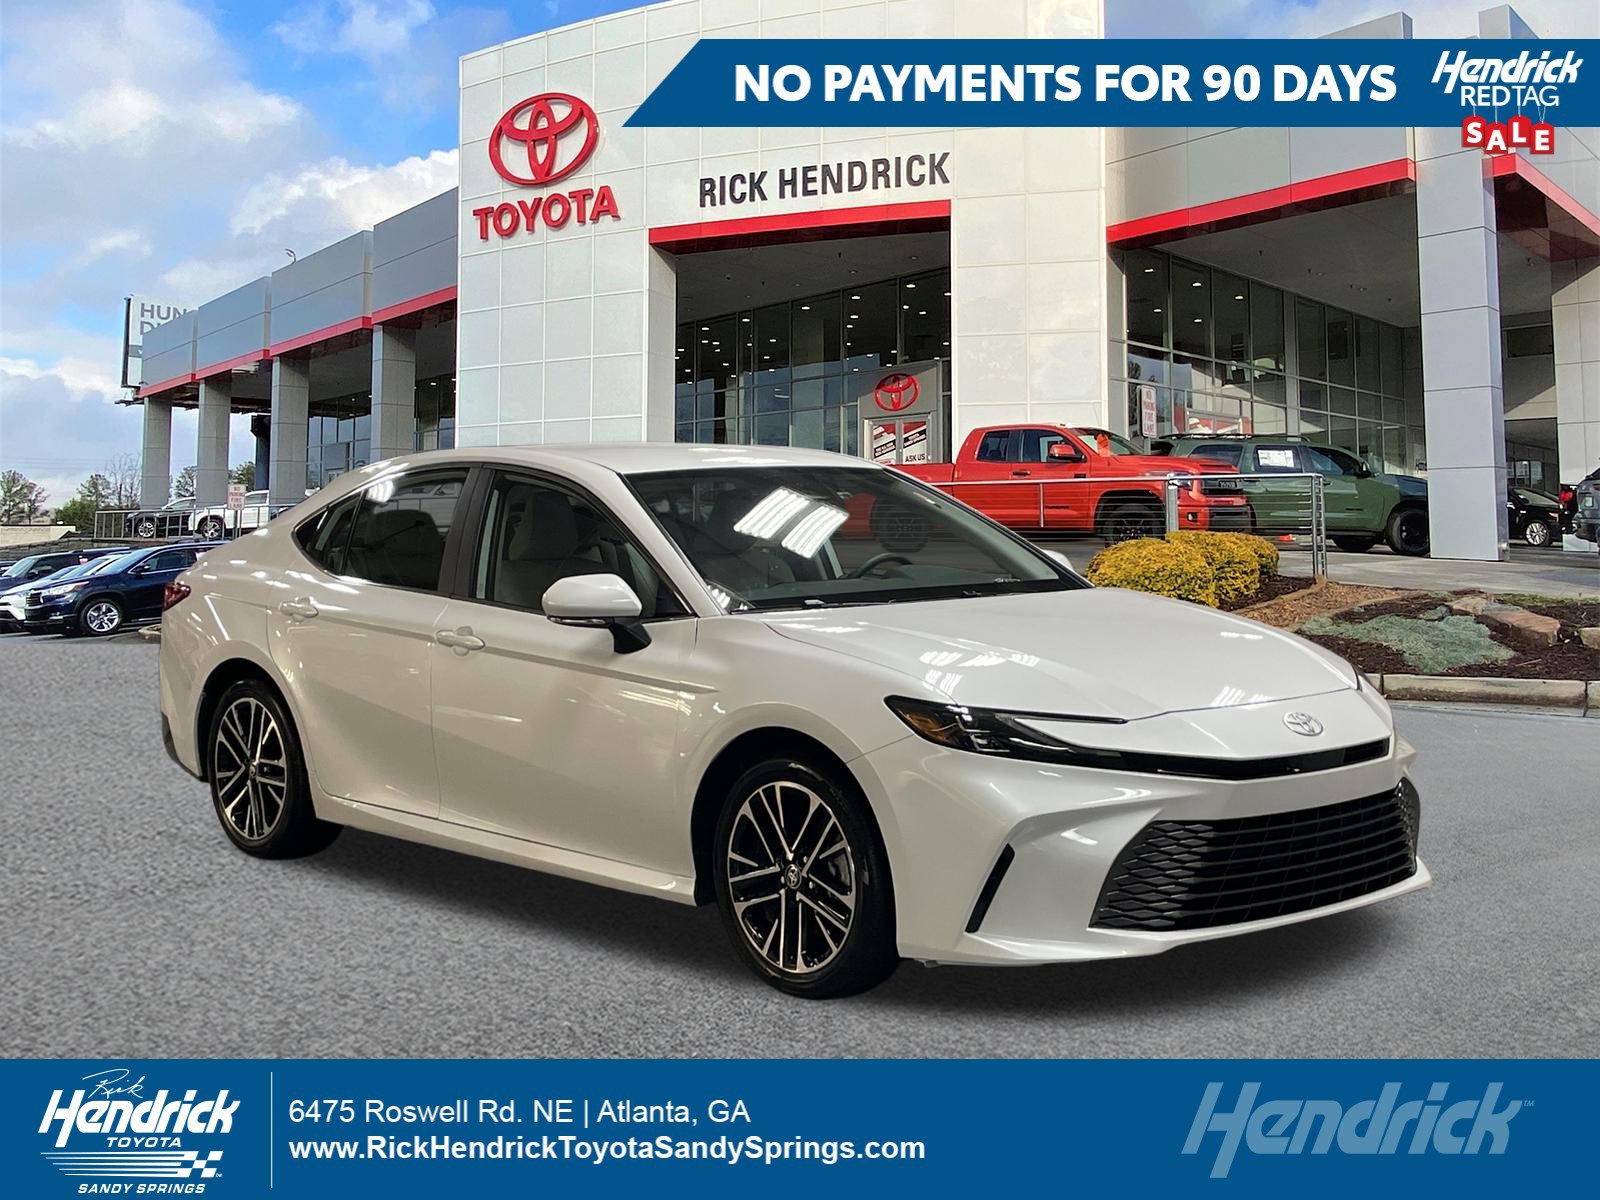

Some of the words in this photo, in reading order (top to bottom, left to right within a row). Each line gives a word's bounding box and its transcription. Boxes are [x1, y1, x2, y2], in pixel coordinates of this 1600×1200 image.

[699, 170, 768, 208] RICK
[778, 152, 950, 199] HENDRICK
[473, 185, 620, 240] TOYOTA
[917, 453, 926, 461] US
